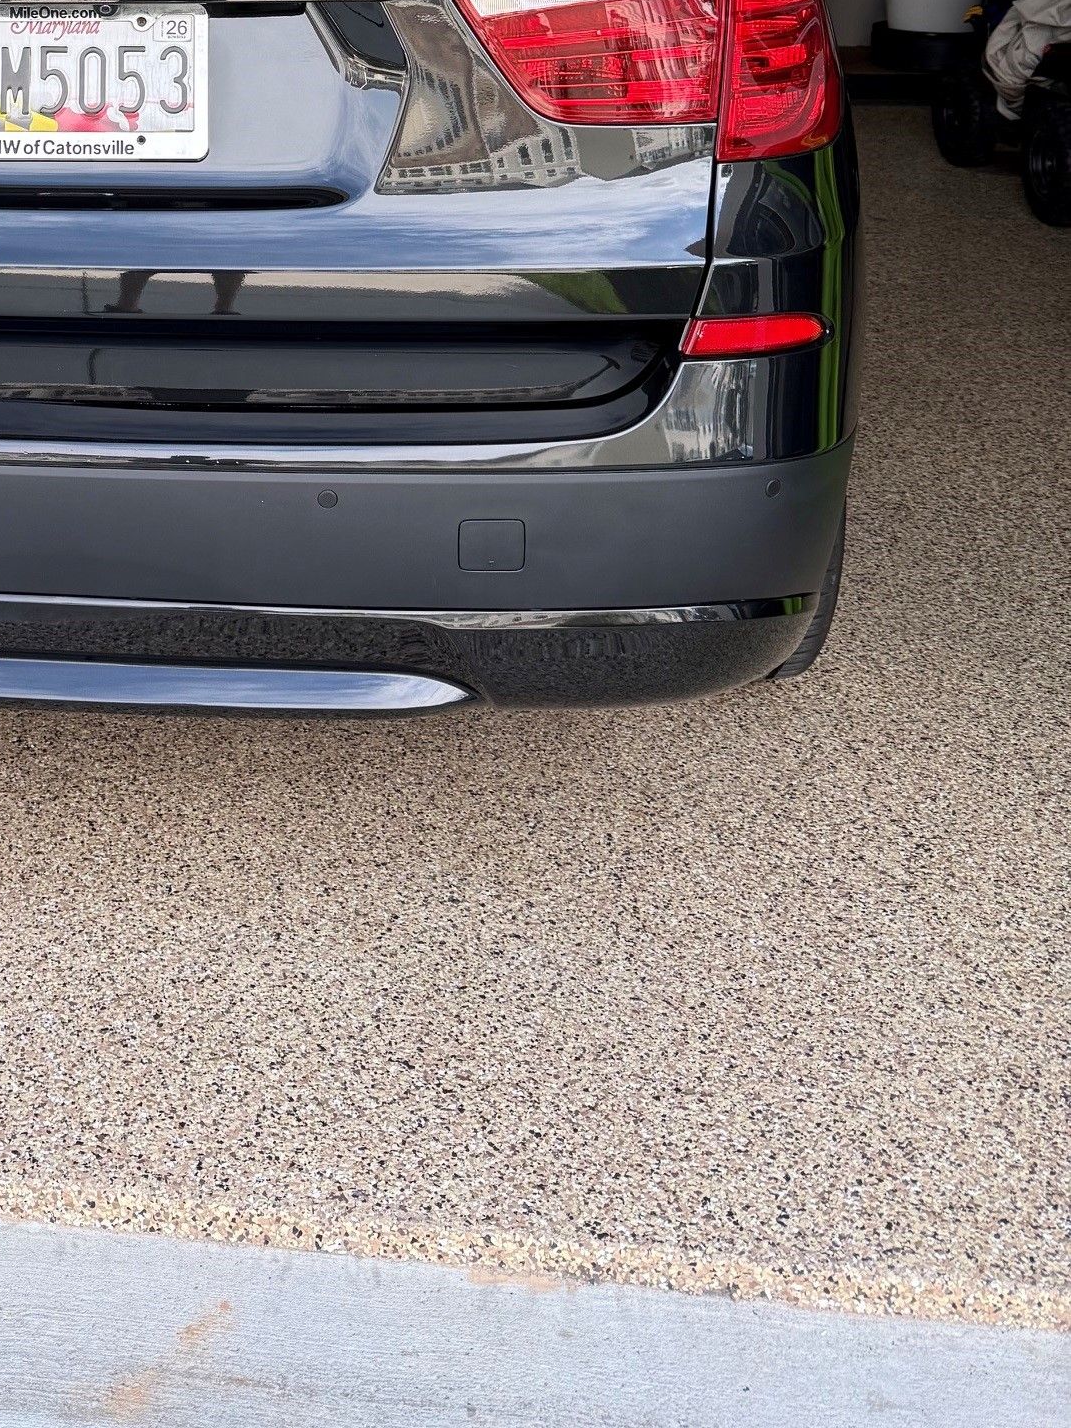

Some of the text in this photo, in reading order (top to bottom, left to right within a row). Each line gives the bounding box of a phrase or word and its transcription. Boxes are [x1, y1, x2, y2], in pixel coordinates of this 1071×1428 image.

[10, 6, 101, 19] MileOne.com
[167, 20, 187, 35] 26
[24, 140, 41, 154] of
[44, 140, 134, 154] Catonsville
